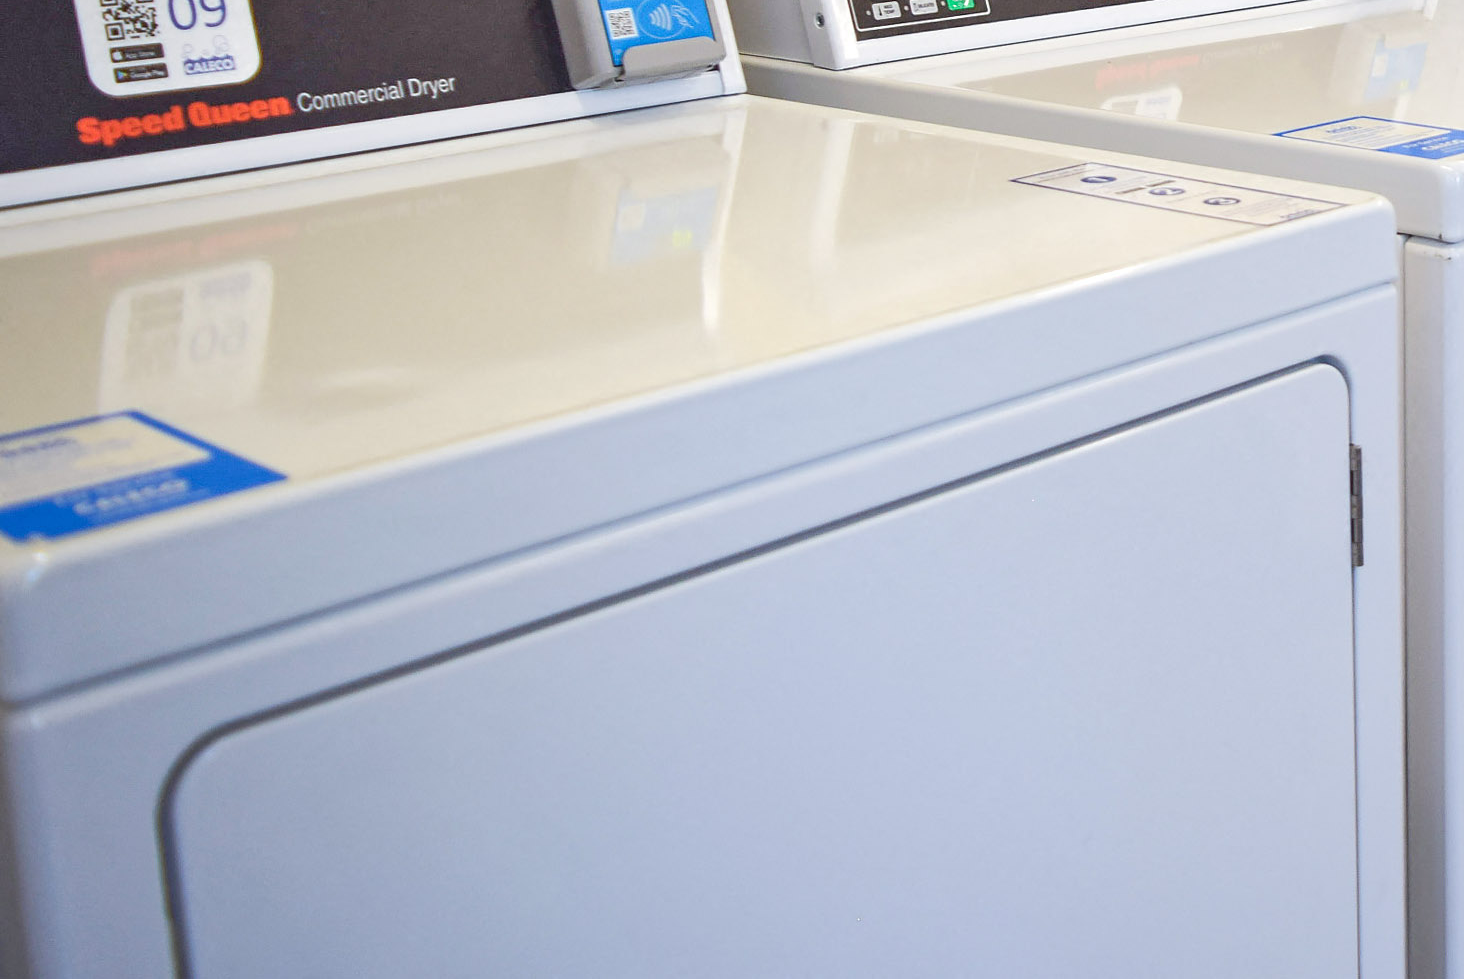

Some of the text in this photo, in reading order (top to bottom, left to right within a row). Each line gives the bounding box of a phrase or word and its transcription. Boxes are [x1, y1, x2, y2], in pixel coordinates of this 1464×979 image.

[185, 58, 235, 73] CALECO
[75, 75, 457, 148] Speed Queen Commercial Dryer
